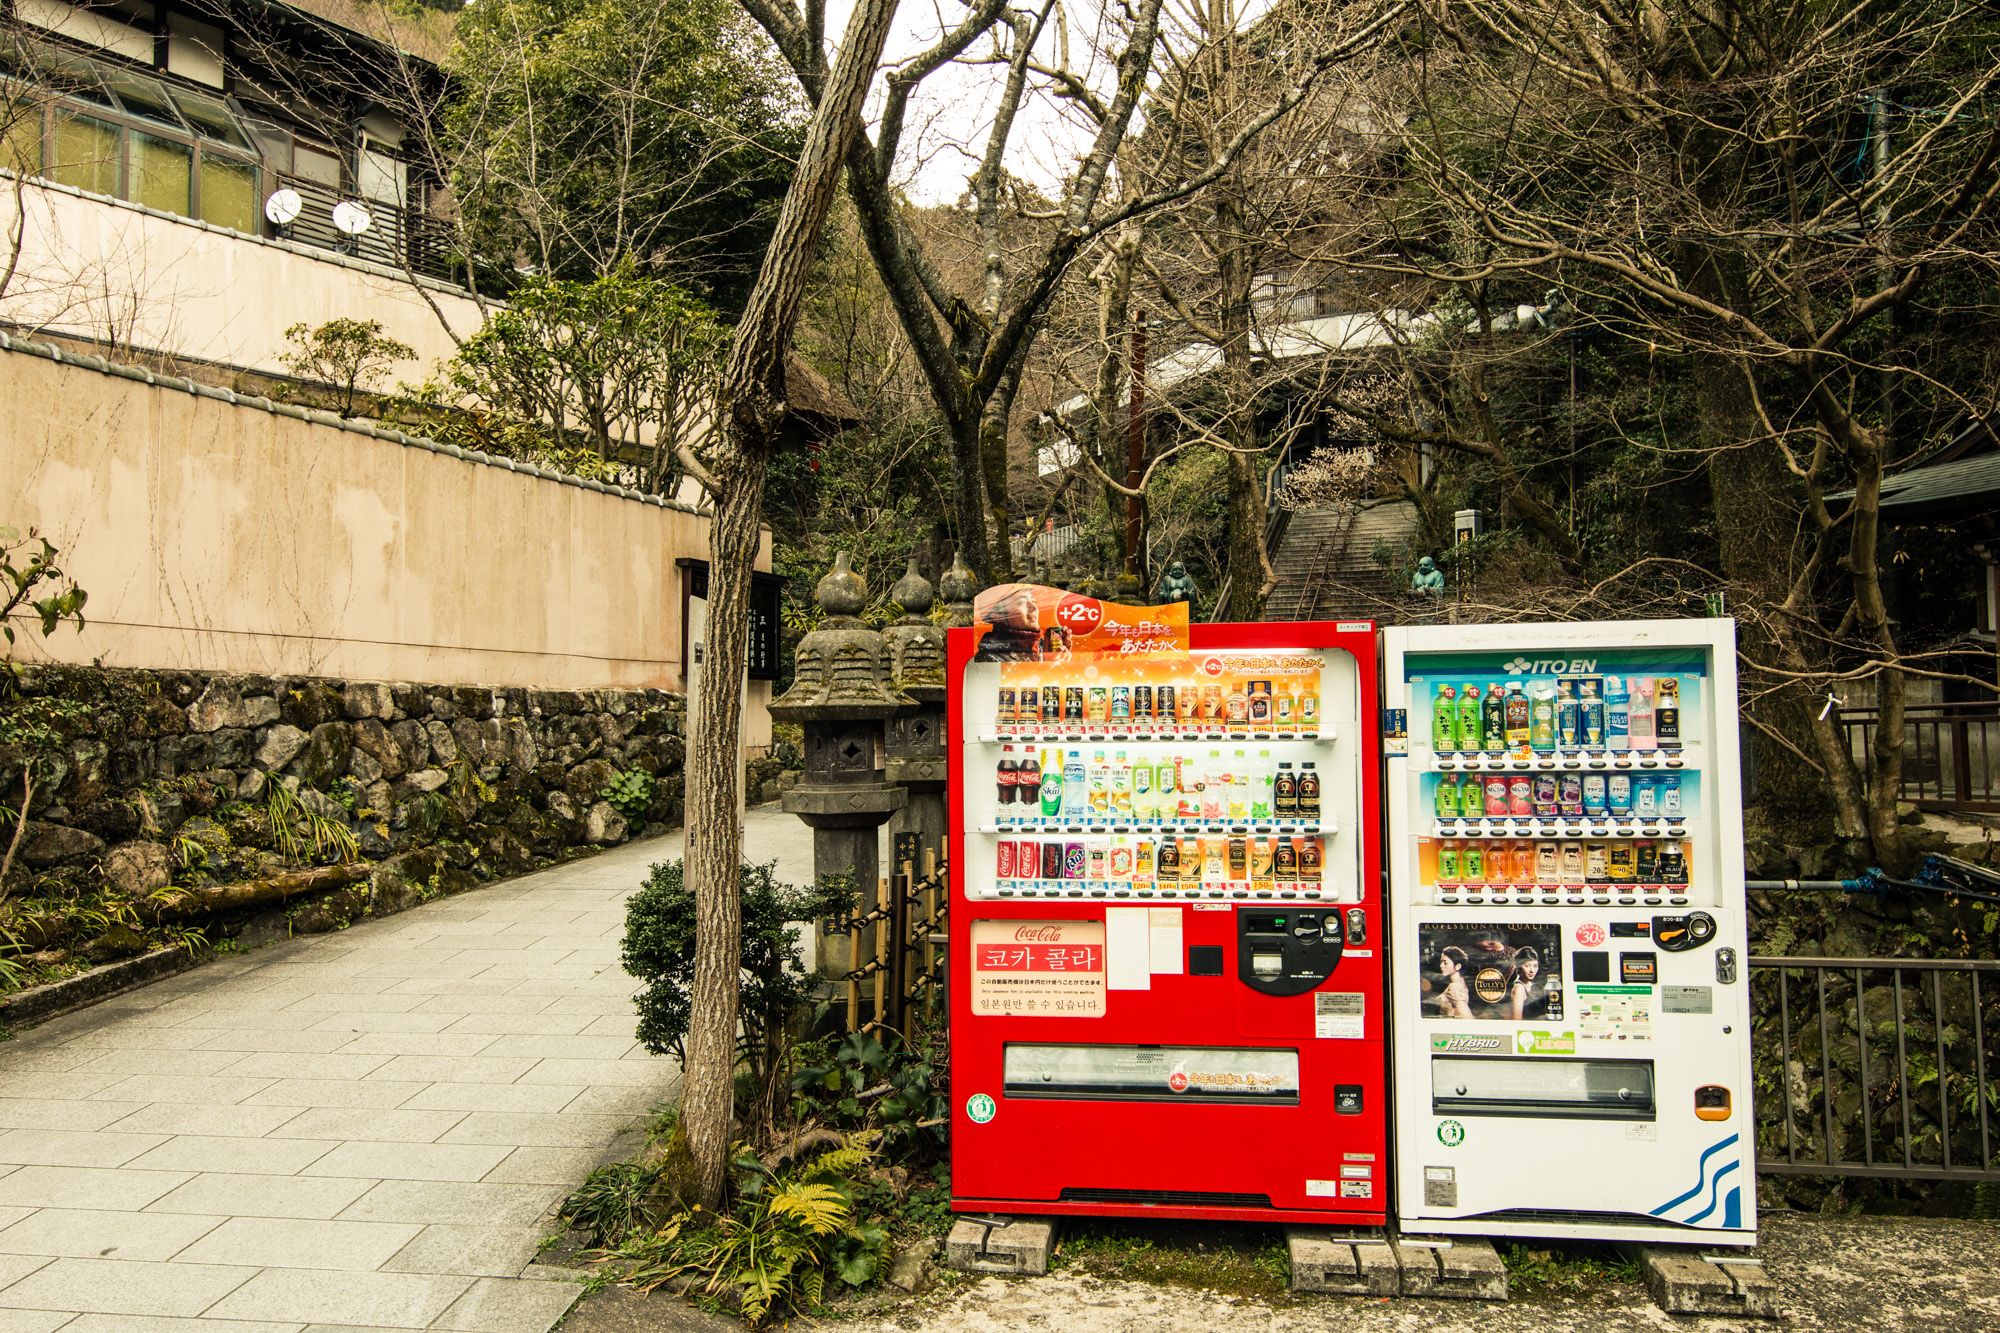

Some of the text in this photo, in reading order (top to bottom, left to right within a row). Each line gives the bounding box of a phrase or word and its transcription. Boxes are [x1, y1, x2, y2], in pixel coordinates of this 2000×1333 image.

[1103, 619, 1176, 637] 今年も日本を、
[1120, 638, 1182, 653] あたたかく。
[1531, 659, 1597, 674] ITO EN
[1508, 706, 1527, 716] むぎ茶
[999, 845, 1010, 876] Coca-Cola
[1021, 845, 1031, 877] Coca-Cola
[1046, 845, 1056, 876] Coca-Cola
[1015, 926, 1064, 942] Coca-Cola
[1581, 930, 1599, 944] 30
[984, 947, 1096, 971] 코카 콜라
[1477, 980, 1505, 988] TULLY'S
[980, 999, 1101, 1011] 일본원만 쓸 수 있습니다.
[1447, 1038, 1500, 1049] HYBRID
